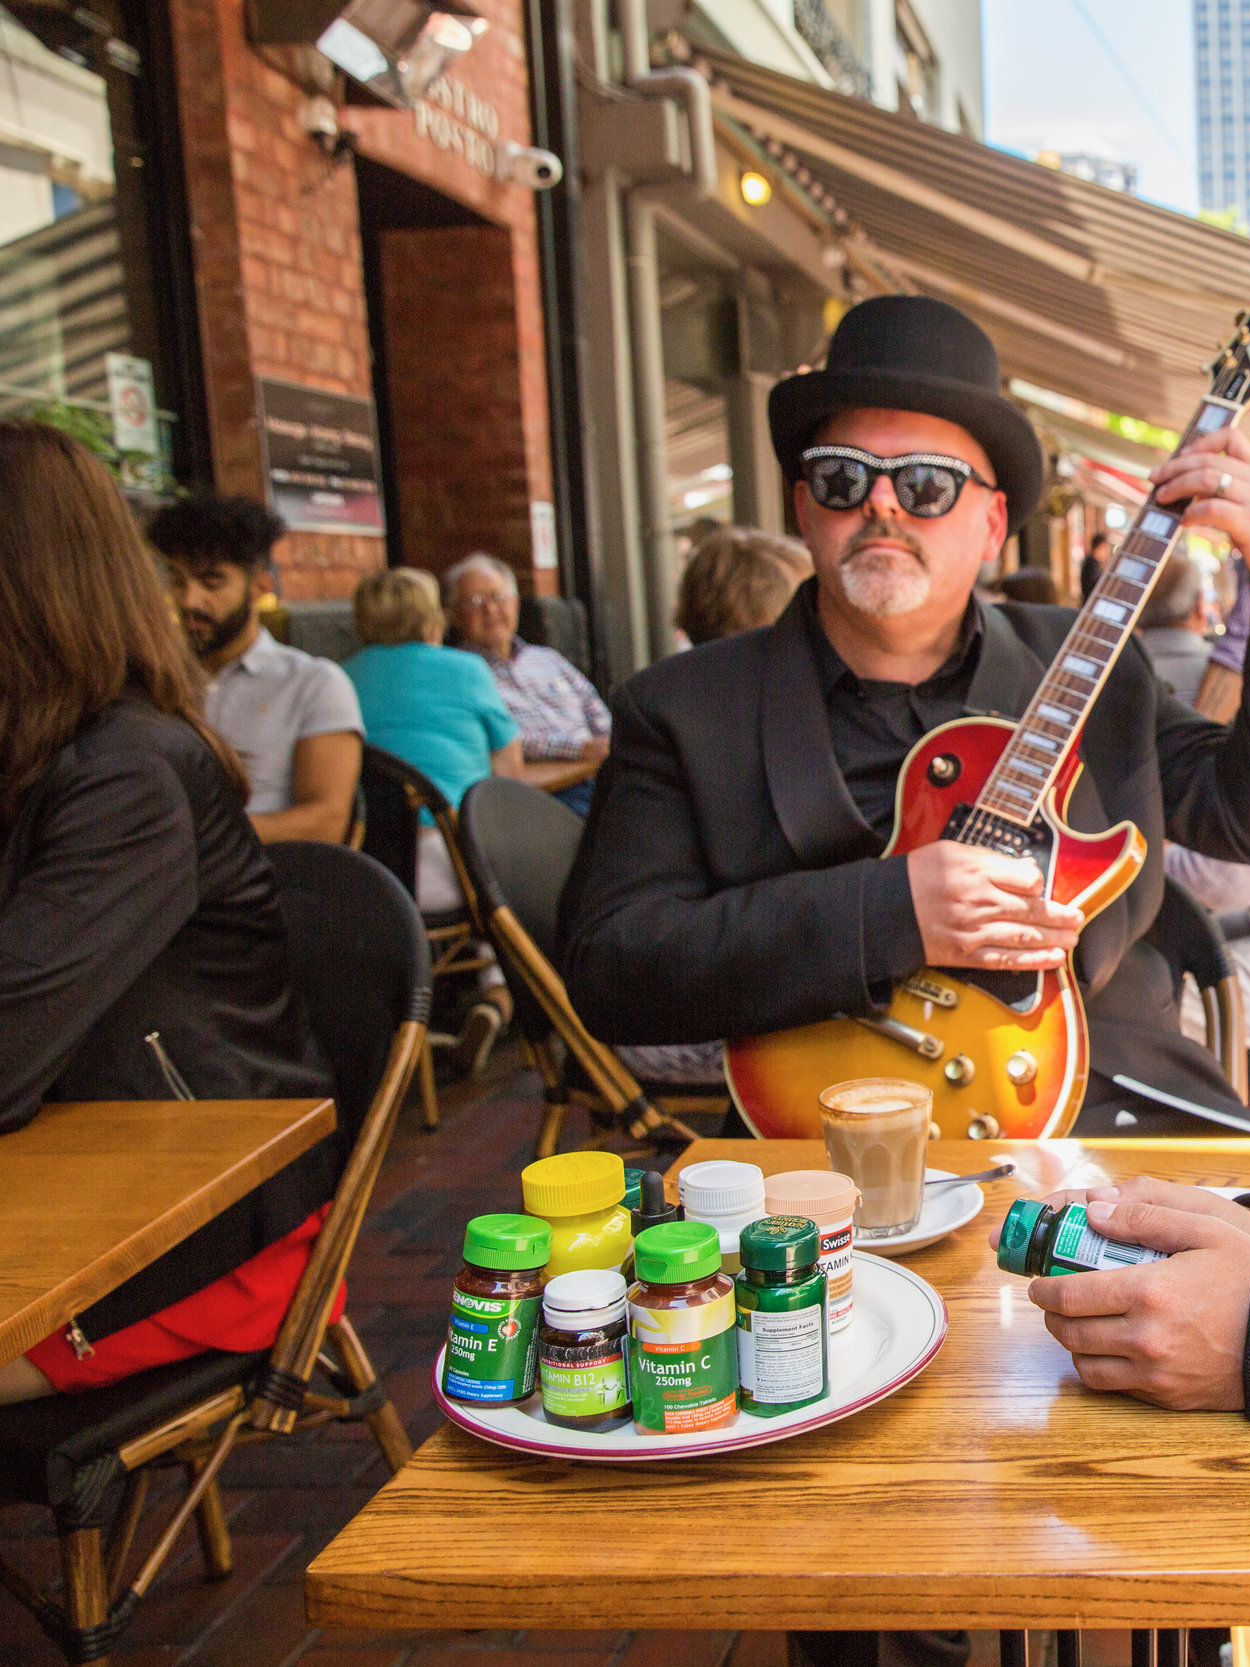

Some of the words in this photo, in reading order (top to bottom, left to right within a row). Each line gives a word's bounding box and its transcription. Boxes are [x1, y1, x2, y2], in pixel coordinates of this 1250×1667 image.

[414, 98, 496, 177] POSTO
[822, 1233, 851, 1250] Swisse
[820, 1255, 849, 1272] TAMIN
[453, 1291, 503, 1313] ENOVIS
[762, 1326, 798, 1334] Supplement
[799, 1322, 814, 1330] Facts
[448, 1327, 483, 1351] itamin
[487, 1338, 498, 1352] E
[450, 1344, 475, 1362] 250mg
[576, 1359, 607, 1368] SUPPORT
[638, 1356, 696, 1375] Vitamin
[701, 1355, 711, 1370] C
[574, 1373, 596, 1387] B12
[655, 1375, 692, 1387] 250mg
